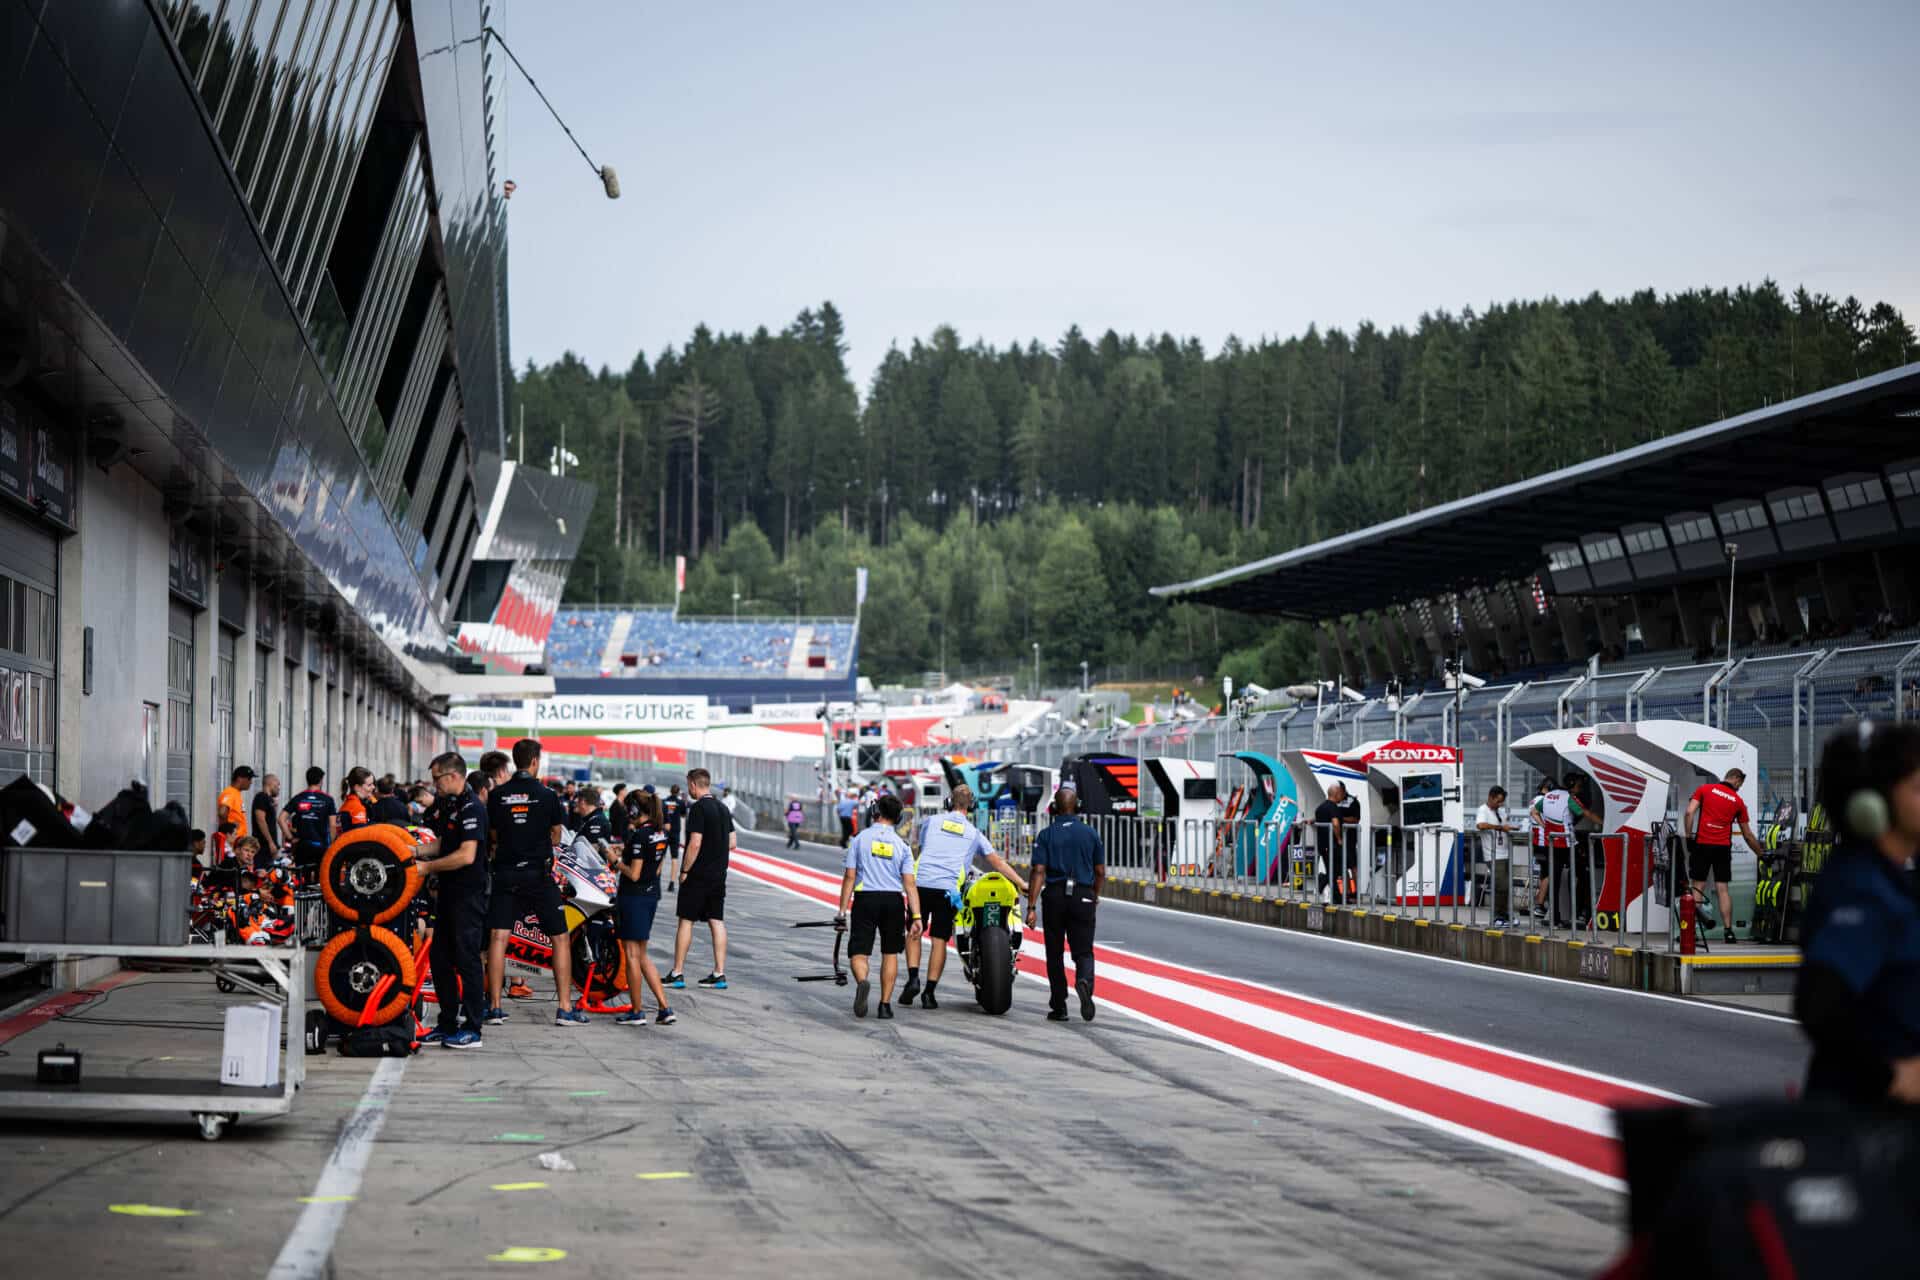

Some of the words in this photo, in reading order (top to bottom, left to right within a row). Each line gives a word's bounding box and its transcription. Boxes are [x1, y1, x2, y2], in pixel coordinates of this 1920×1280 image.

[536, 703, 604, 719] RACING
[625, 703, 696, 720] FUTURE
[1374, 749, 1455, 760] HONDA
[514, 920, 538, 940] Red
